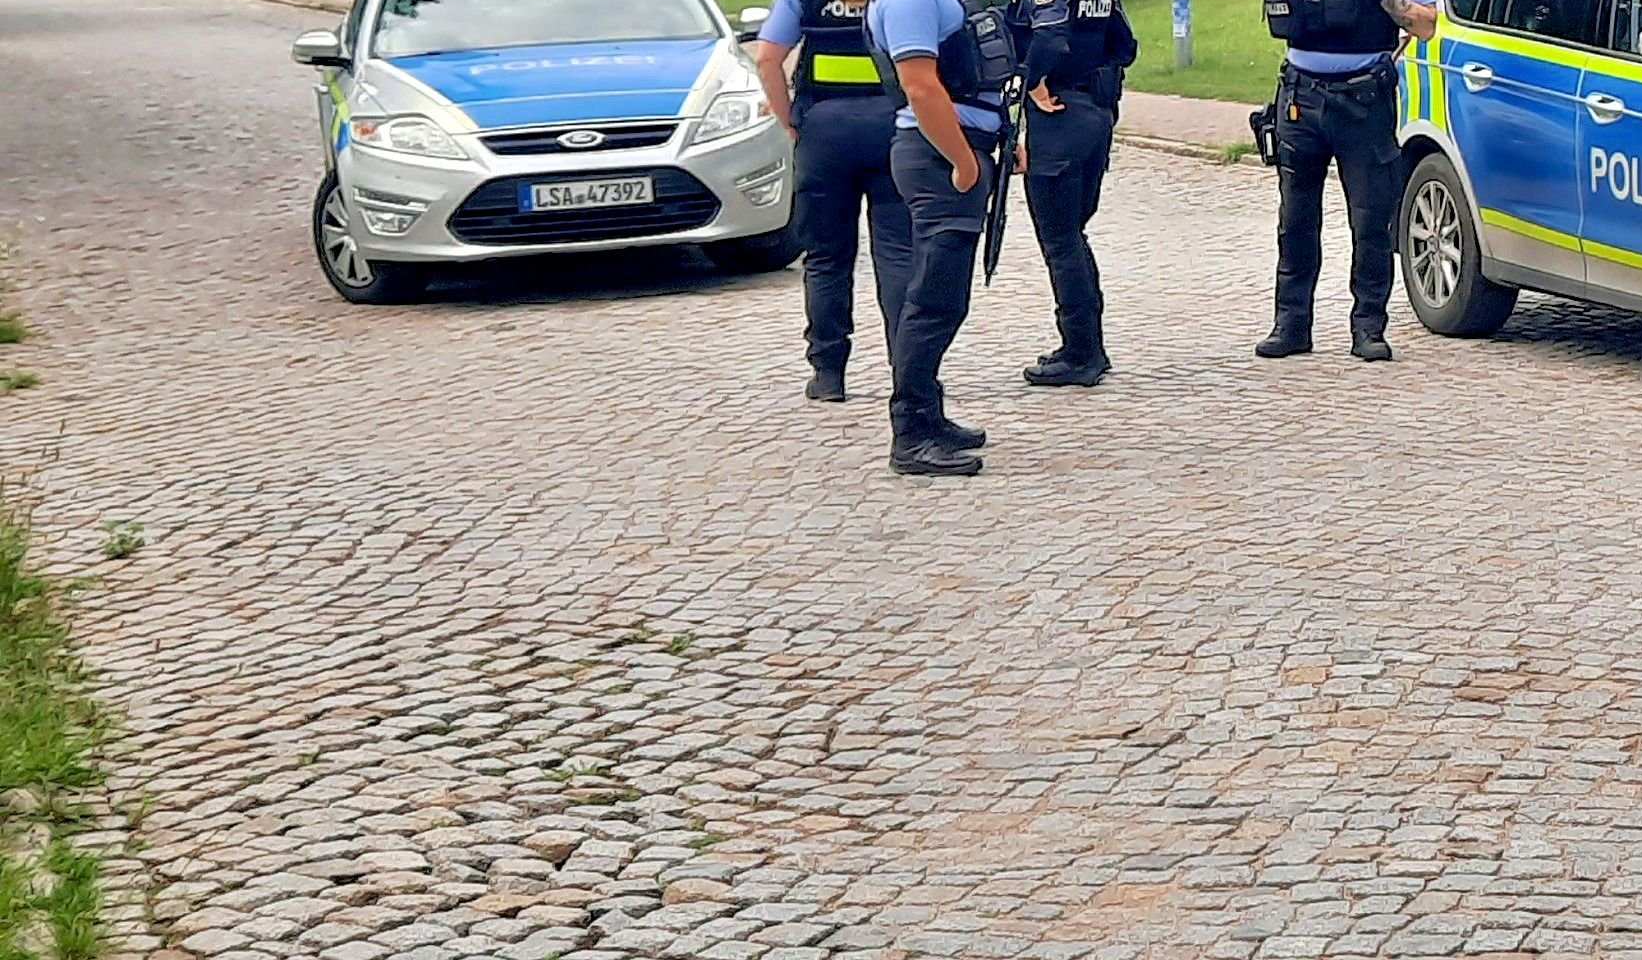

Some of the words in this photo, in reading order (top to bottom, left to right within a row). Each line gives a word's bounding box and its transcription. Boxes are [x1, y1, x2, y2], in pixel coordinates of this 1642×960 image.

[470, 56, 655, 74] POLIZEI
[535, 186, 575, 208] LSA
[586, 181, 646, 204] 47392
